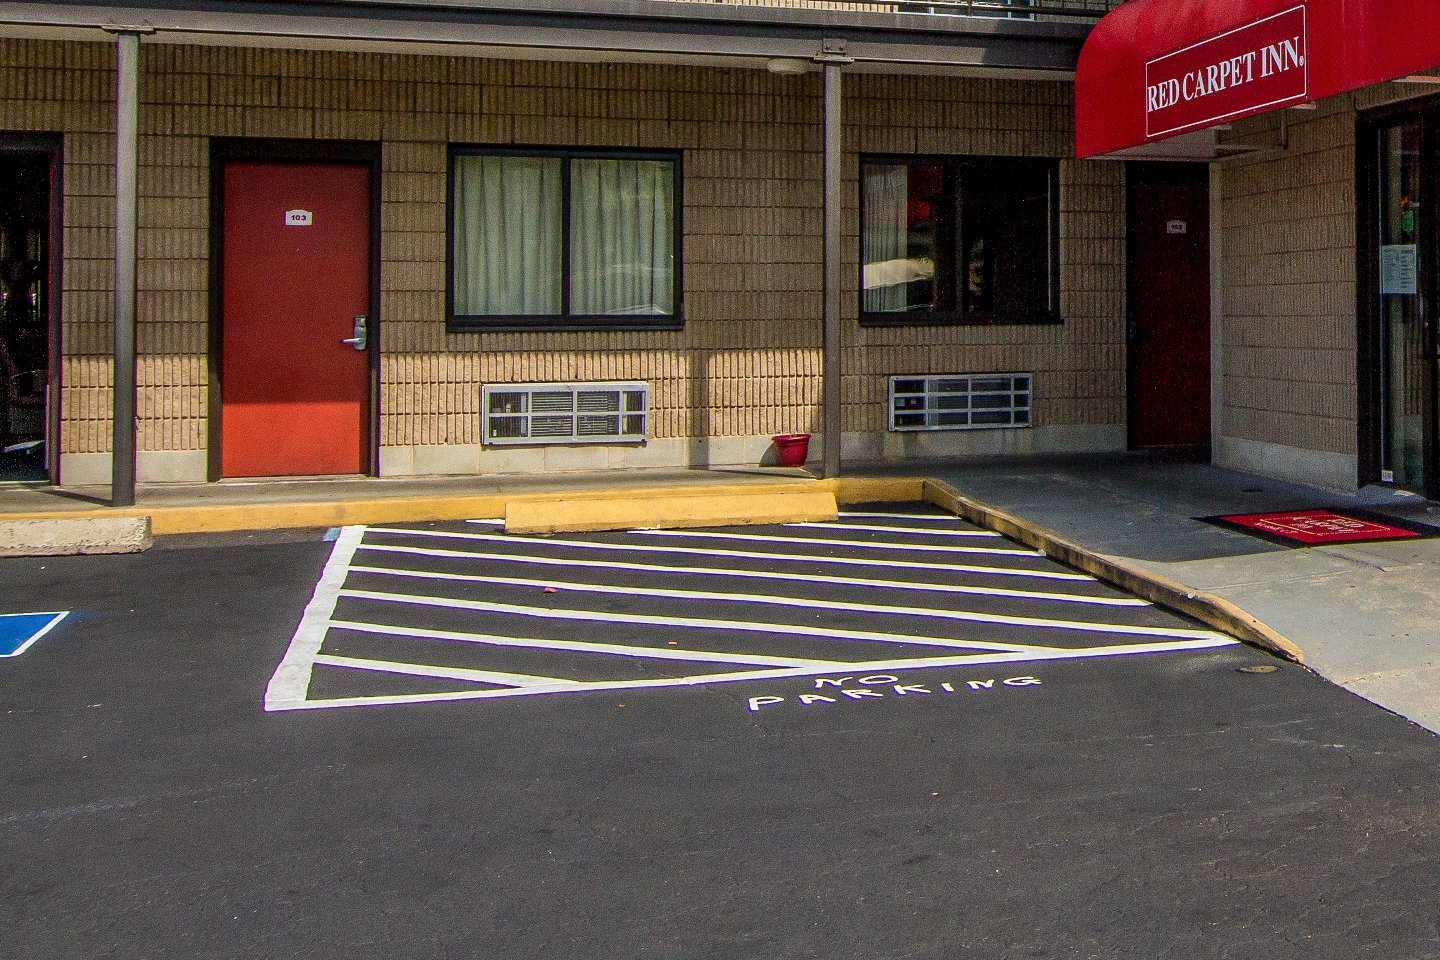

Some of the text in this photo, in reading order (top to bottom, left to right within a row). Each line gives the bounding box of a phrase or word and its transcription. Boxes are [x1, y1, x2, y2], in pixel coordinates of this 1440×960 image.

[1147, 36, 1300, 113] RED CARPET INN
[748, 676, 1042, 711] PARKING
[815, 675, 898, 688] NO
